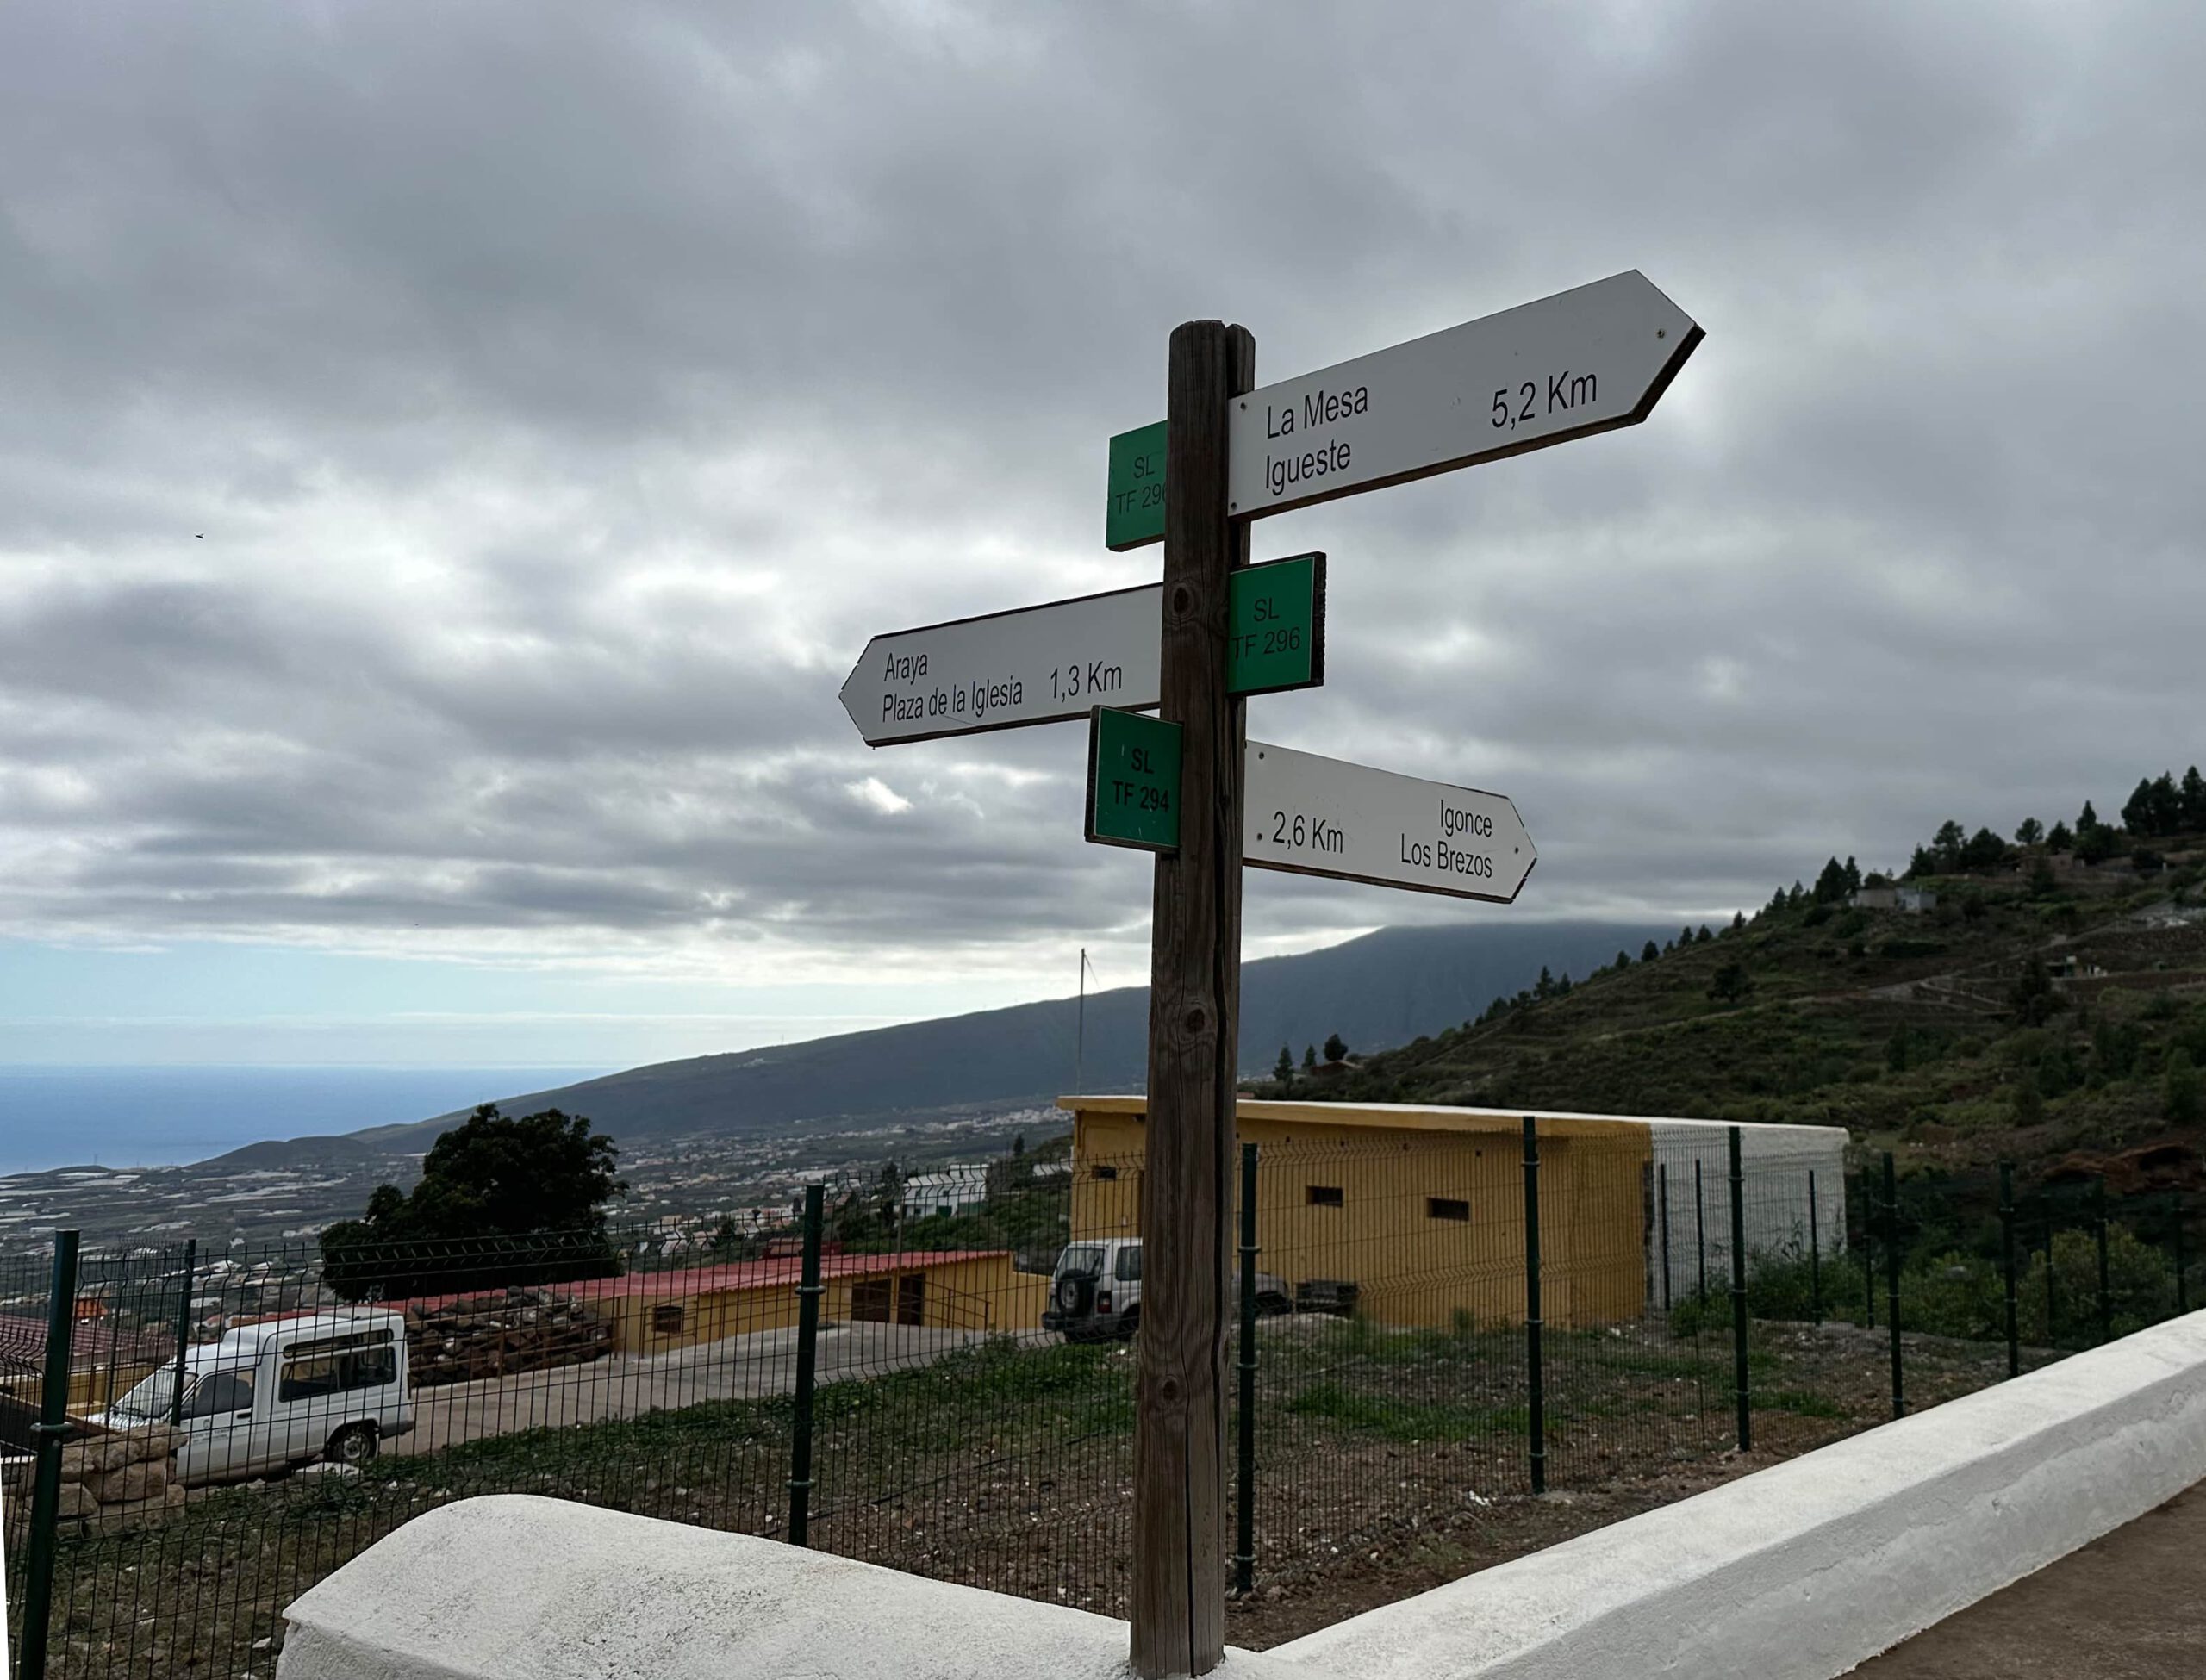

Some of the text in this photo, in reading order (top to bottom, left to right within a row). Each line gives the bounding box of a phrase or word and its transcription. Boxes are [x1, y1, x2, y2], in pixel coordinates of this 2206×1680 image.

[1267, 386, 1368, 439] La Mesa
[1492, 370, 1598, 431] 5,2 Km
[1133, 455, 1155, 479] SL
[1265, 438, 1352, 497] Igueste
[1116, 489, 1137, 515] TF
[1253, 596, 1281, 622] SL
[1231, 626, 1301, 661] TF 296
[883, 652, 928, 686] Araya
[1050, 660, 1123, 704] 1,3 Km
[882, 675, 1023, 723] Plaza de la Iglesia
[1131, 747, 1155, 775] SL
[1112, 780, 1170, 813] TF 294
[1272, 810, 1344, 855] 2,6 Km
[1440, 799, 1492, 838] Igonce
[1401, 832, 1492, 879] Los Brezos
